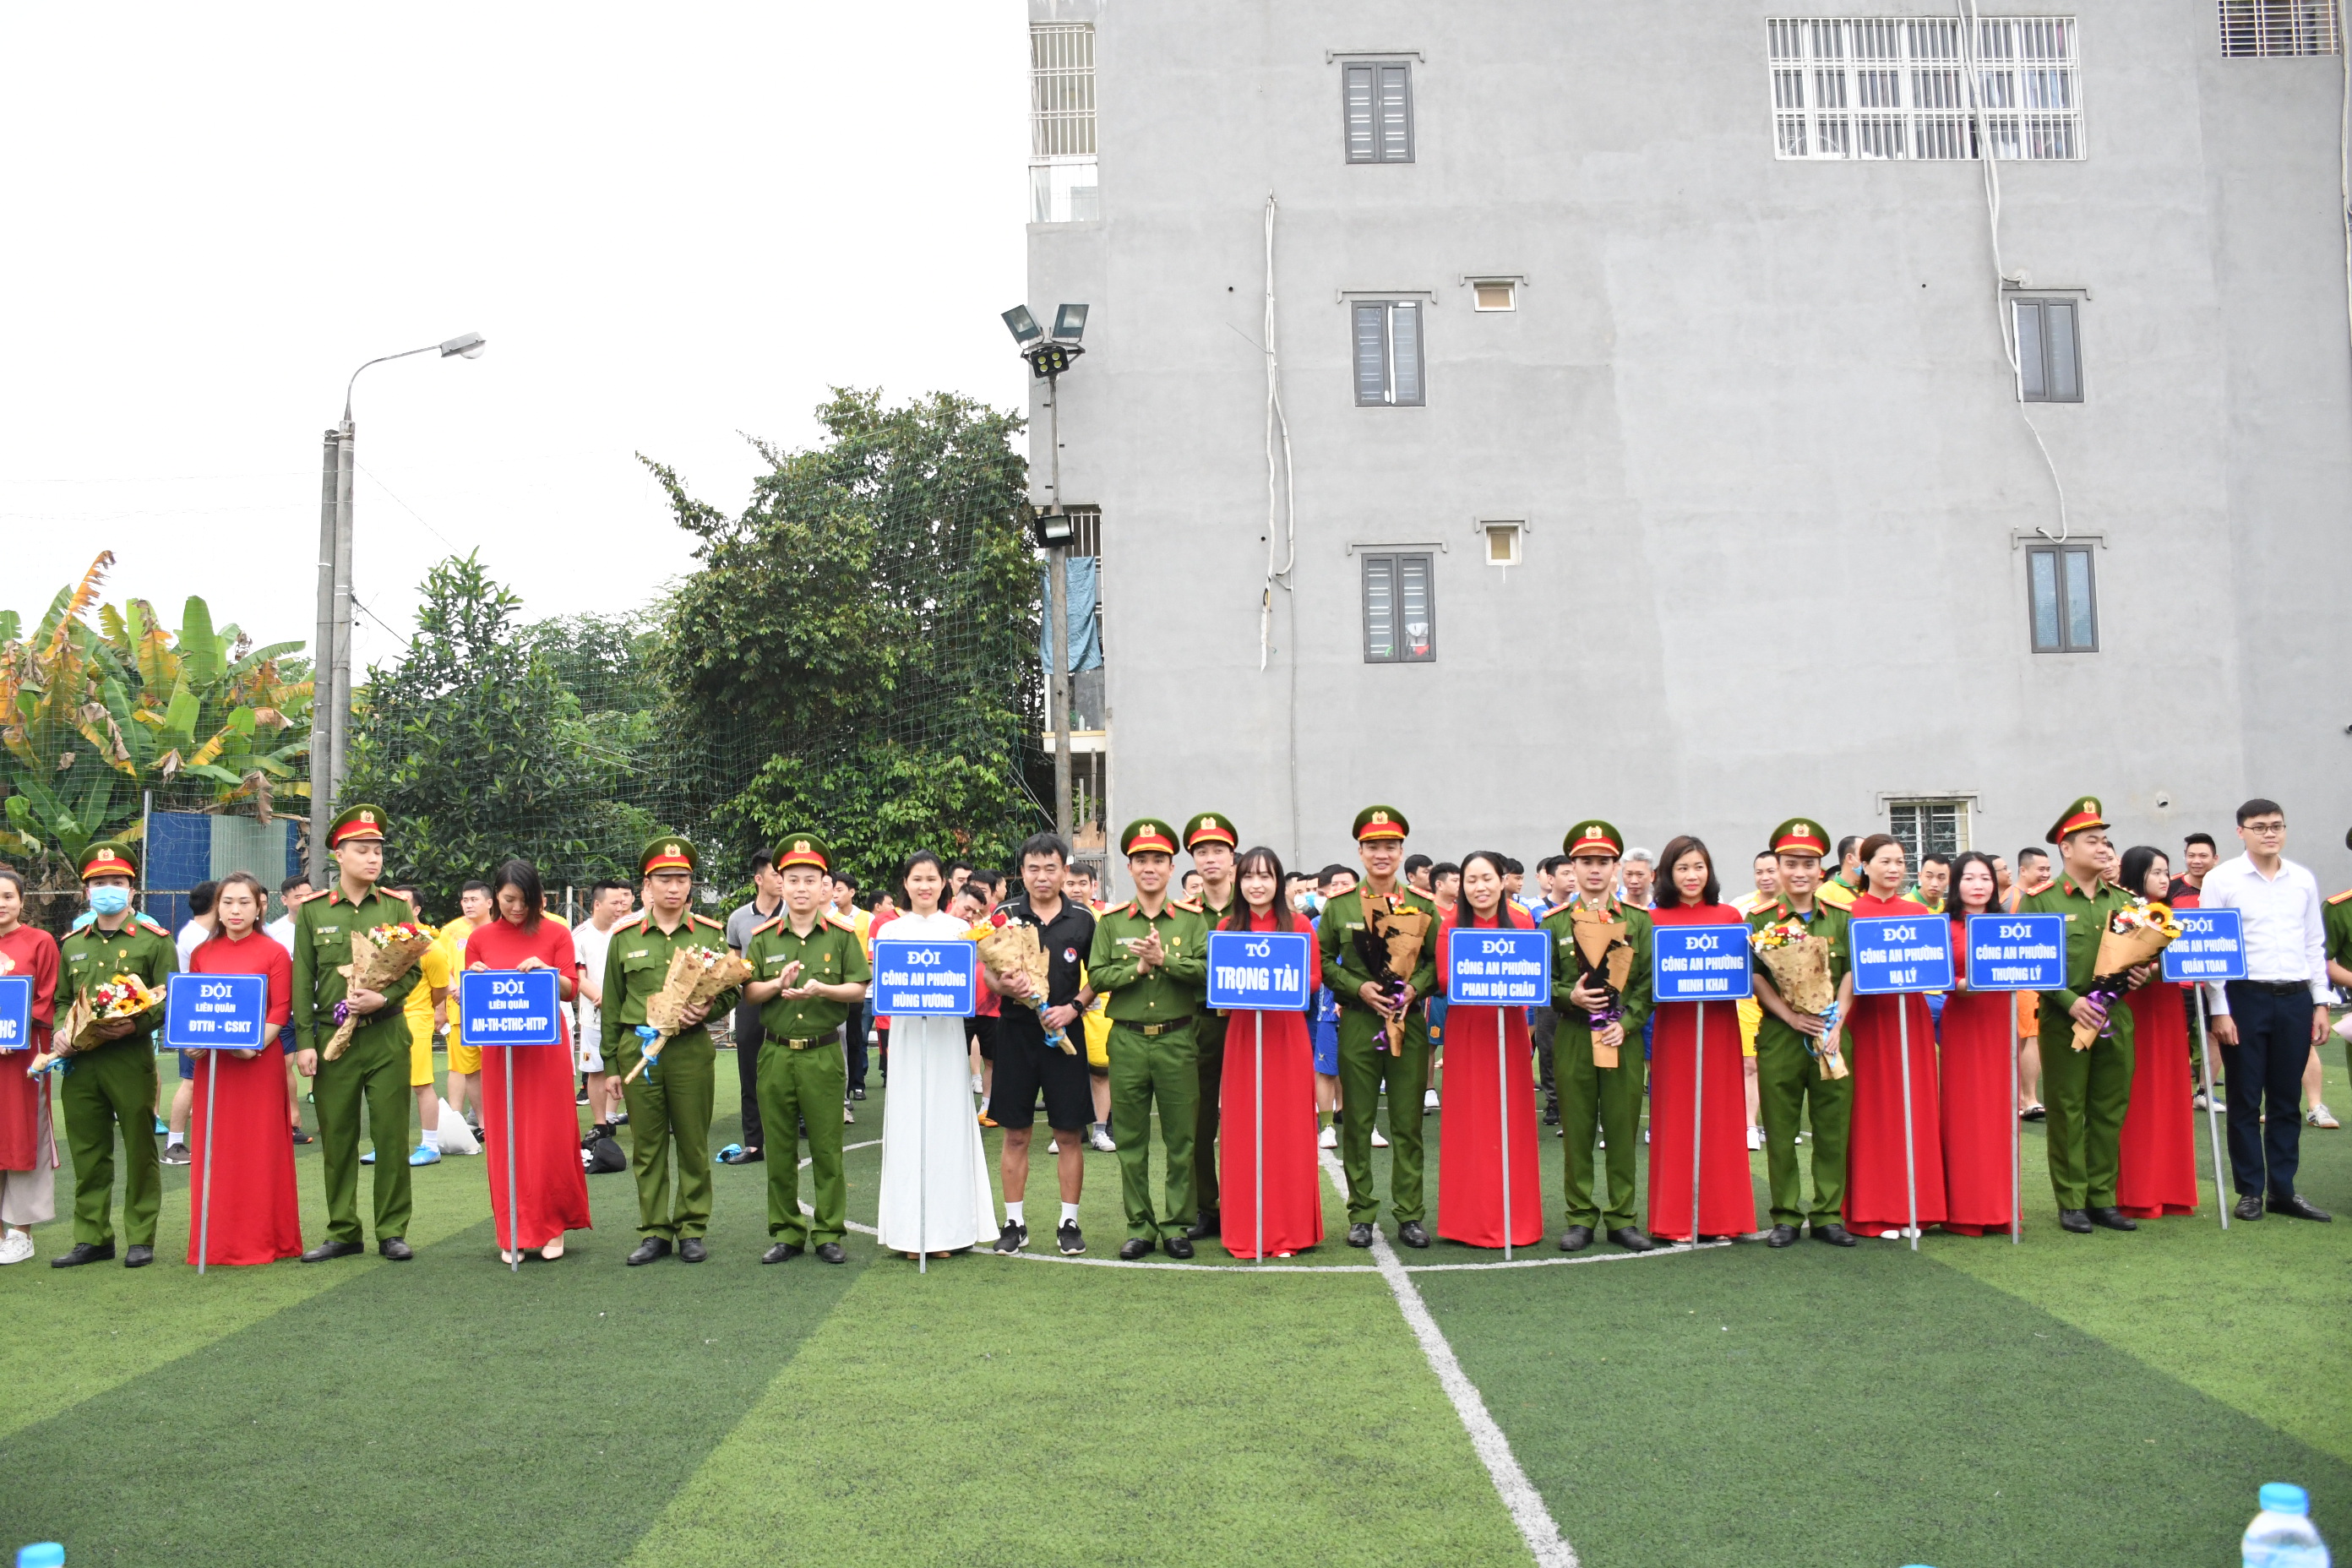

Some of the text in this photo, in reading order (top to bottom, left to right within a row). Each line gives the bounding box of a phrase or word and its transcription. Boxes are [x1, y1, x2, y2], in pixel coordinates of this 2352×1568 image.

[1883, 925, 1917, 943] ĐỘI
[1999, 923, 2032, 940] ĐỘI
[2185, 917, 2213, 934] ĐỘI
[1245, 939, 1271, 957] TỔ
[1482, 938, 1516, 956] ĐỘI
[1685, 934, 1718, 951] ĐỘI
[2191, 939, 2203, 952] AN
[2203, 936, 2237, 952] PHƯỜNG
[906, 949, 941, 967] ĐỘI
[1859, 945, 1944, 964] CÔNG AN PHƯỜNG
[1976, 943, 2056, 960] CÔNG AN PHƯỜNG
[1456, 958, 1541, 976] CÔNG AN PHƯỜNG
[1661, 954, 1744, 972] CÔNG AN PHƯỜNG
[2205, 960, 2227, 972] TOAN
[881, 969, 966, 987] CÔNG AN PHƯỜNG
[1216, 963, 1298, 994] TRỌNG TÀI
[1889, 966, 1917, 986] HẠ LÝ
[1991, 965, 2041, 983] THƯỢNG LÝ
[200, 982, 232, 999] ĐỘI
[493, 978, 525, 996] ĐỘI
[1462, 981, 1536, 999] PHAN BỘI CHÂU
[1678, 978, 1728, 992] MINH KHAI
[195, 1002, 236, 1013] LIÊN QUÂN
[489, 999, 529, 1010] LIÊN QUÂN
[892, 991, 955, 1008] HÙNG VƯƠNG
[188, 1020, 215, 1032] ĐTTH
[225, 1021, 252, 1032] CSKT
[472, 1017, 547, 1032] AN-TH-CTHC-HTTP
